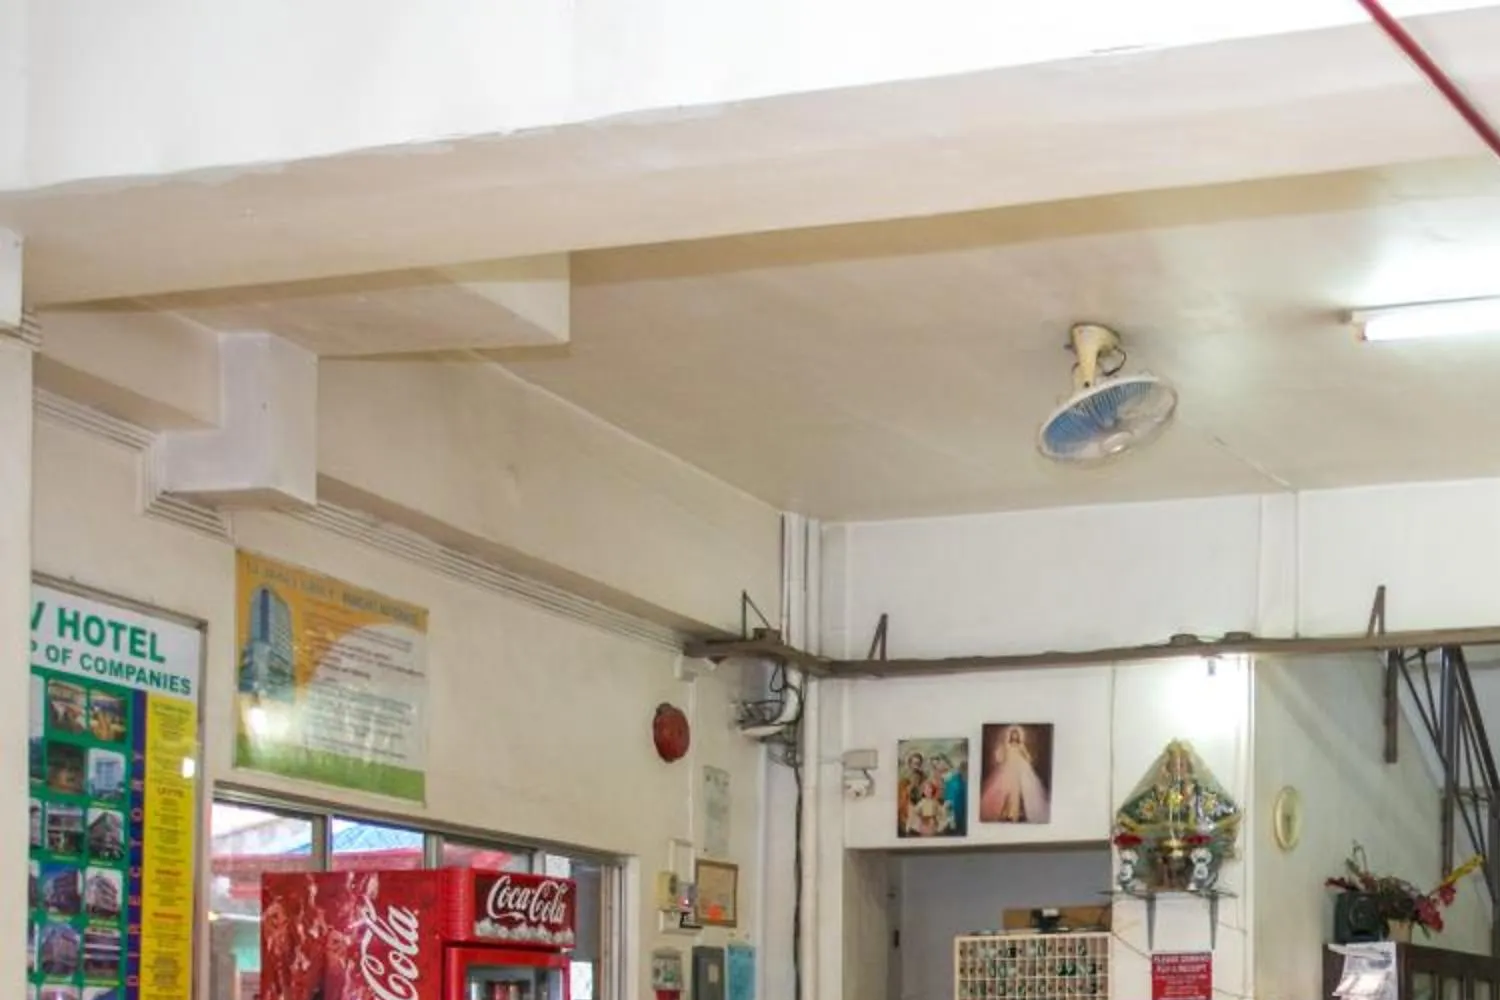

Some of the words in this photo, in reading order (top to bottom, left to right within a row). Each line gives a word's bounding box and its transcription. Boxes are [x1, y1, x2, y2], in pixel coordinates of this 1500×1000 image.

[57, 607, 166, 664] HOTEL
[45, 644, 73, 666] OF
[79, 653, 192, 696] COMPANIES
[127, 751, 145, 987] DIRECTORY
[486, 875, 568, 924] Coca-Cola
